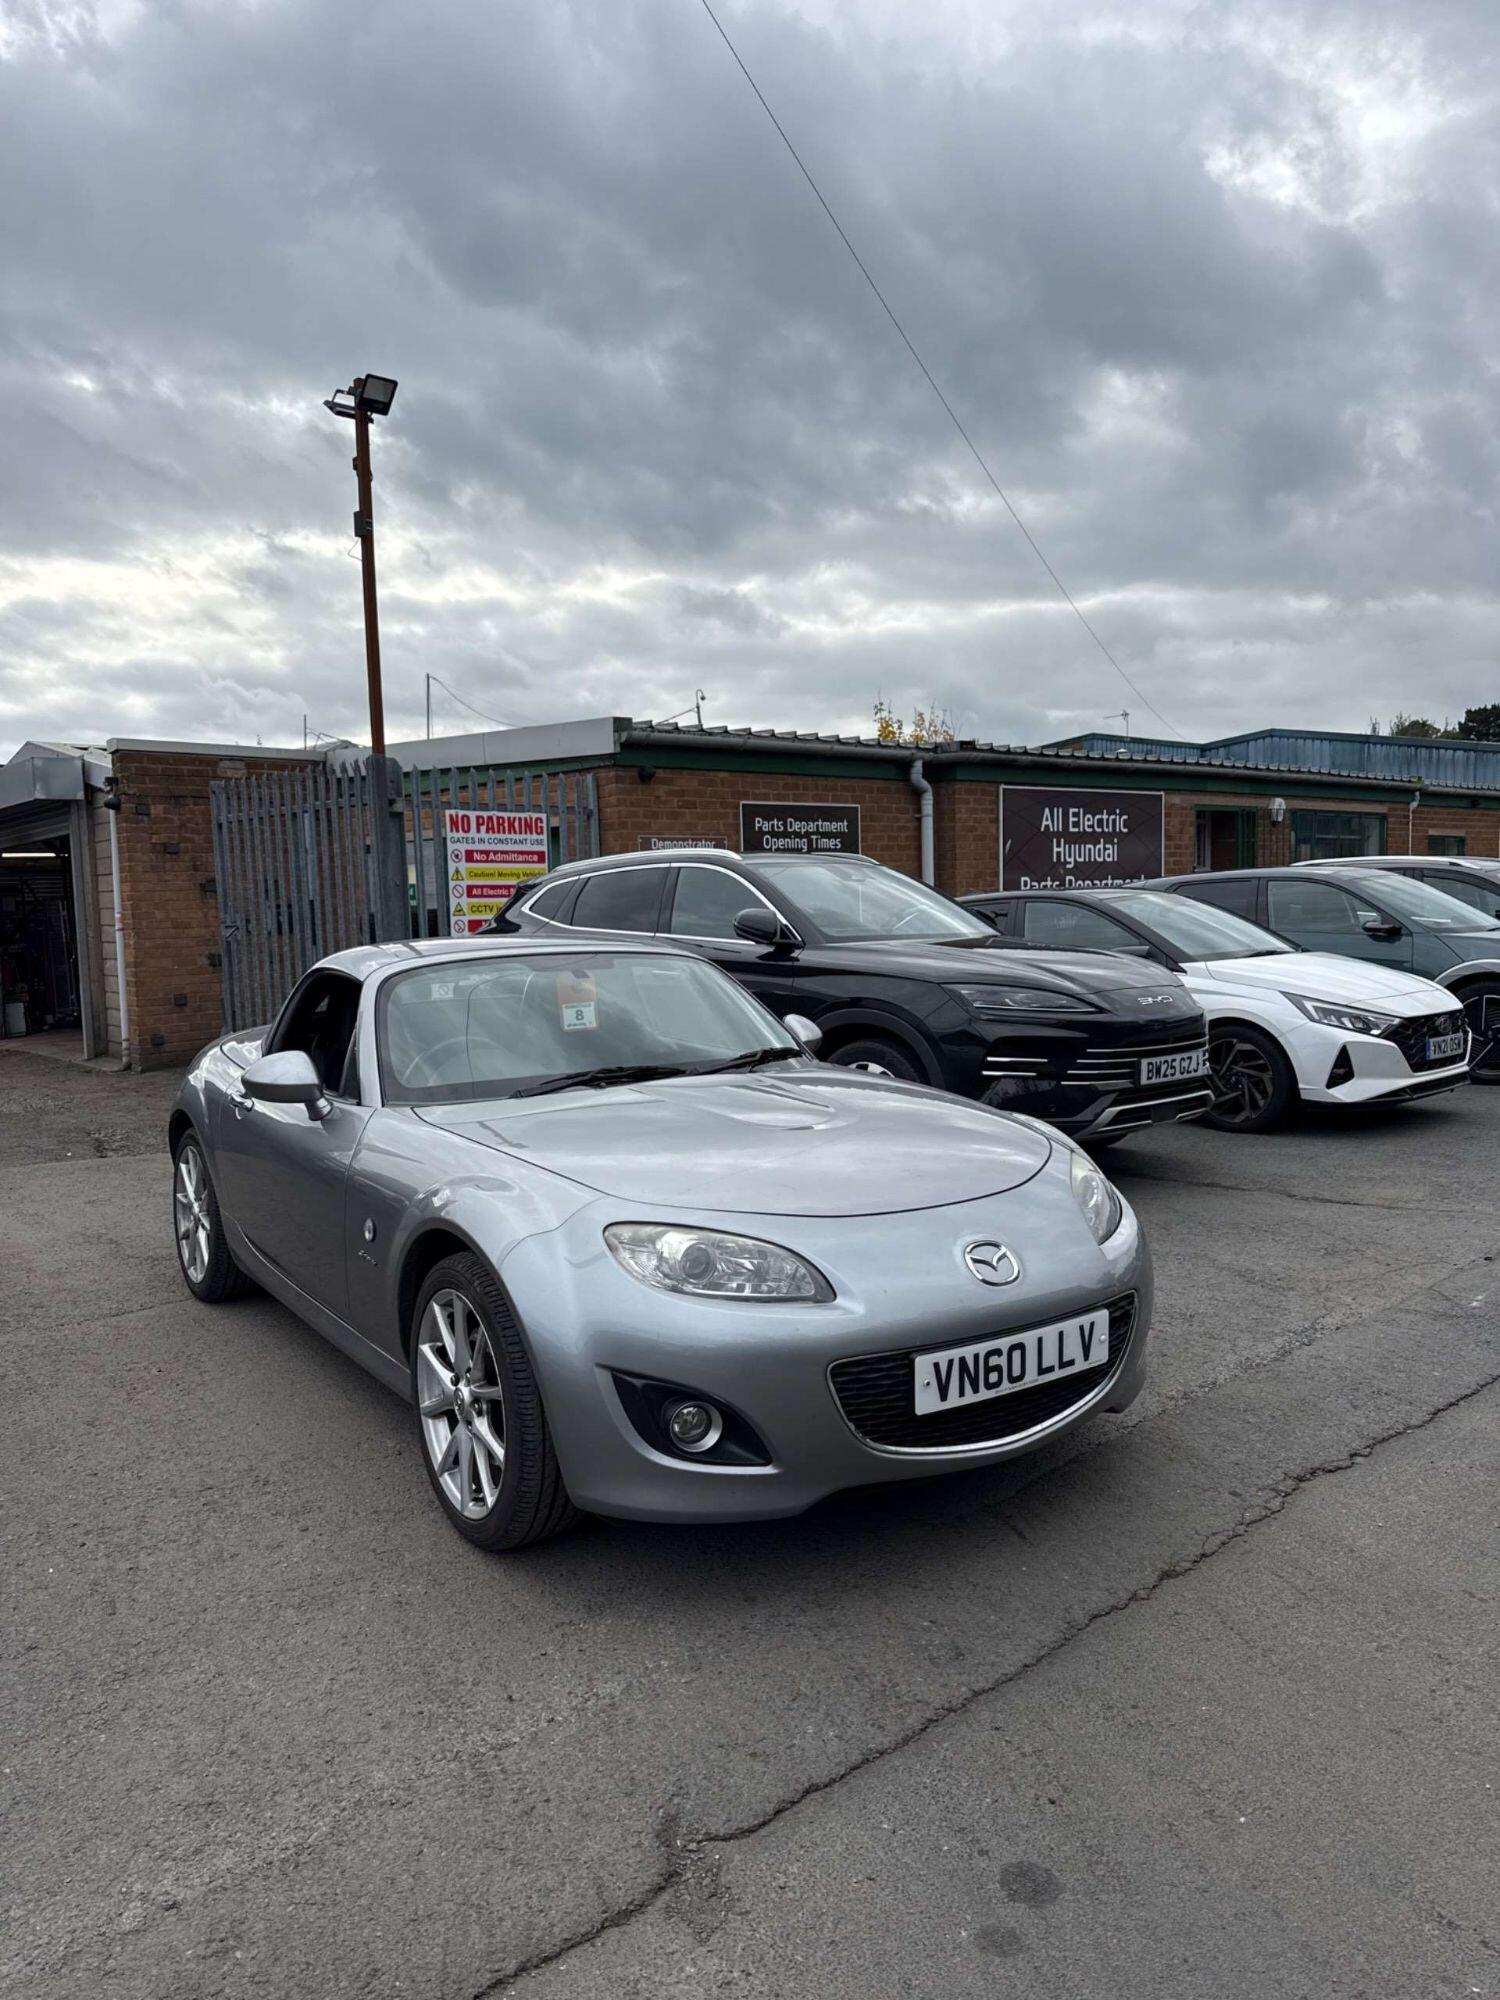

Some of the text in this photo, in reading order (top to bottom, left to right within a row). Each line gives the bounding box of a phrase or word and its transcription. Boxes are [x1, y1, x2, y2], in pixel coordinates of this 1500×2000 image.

[449, 813, 545, 836] NO PARKING
[755, 817, 848, 834] Parts Department
[1040, 807, 1129, 832] All Electric
[450, 836, 545, 847] GATES IN CONSTANT USE
[651, 837, 716, 849] Demonstrator
[763, 835, 841, 852] Opening Times
[473, 851, 539, 862] No Admittance
[1053, 838, 1119, 869] Hyundai
[469, 870, 496, 878] Caution!
[497, 870, 521, 880] Moving
[472, 887, 482, 896] All
[483, 887, 509, 896] Electric
[470, 904, 494, 914] CCTV
[575, 1009, 584, 1021] 8
[933, 1320, 1096, 1403] VN60 LLV
